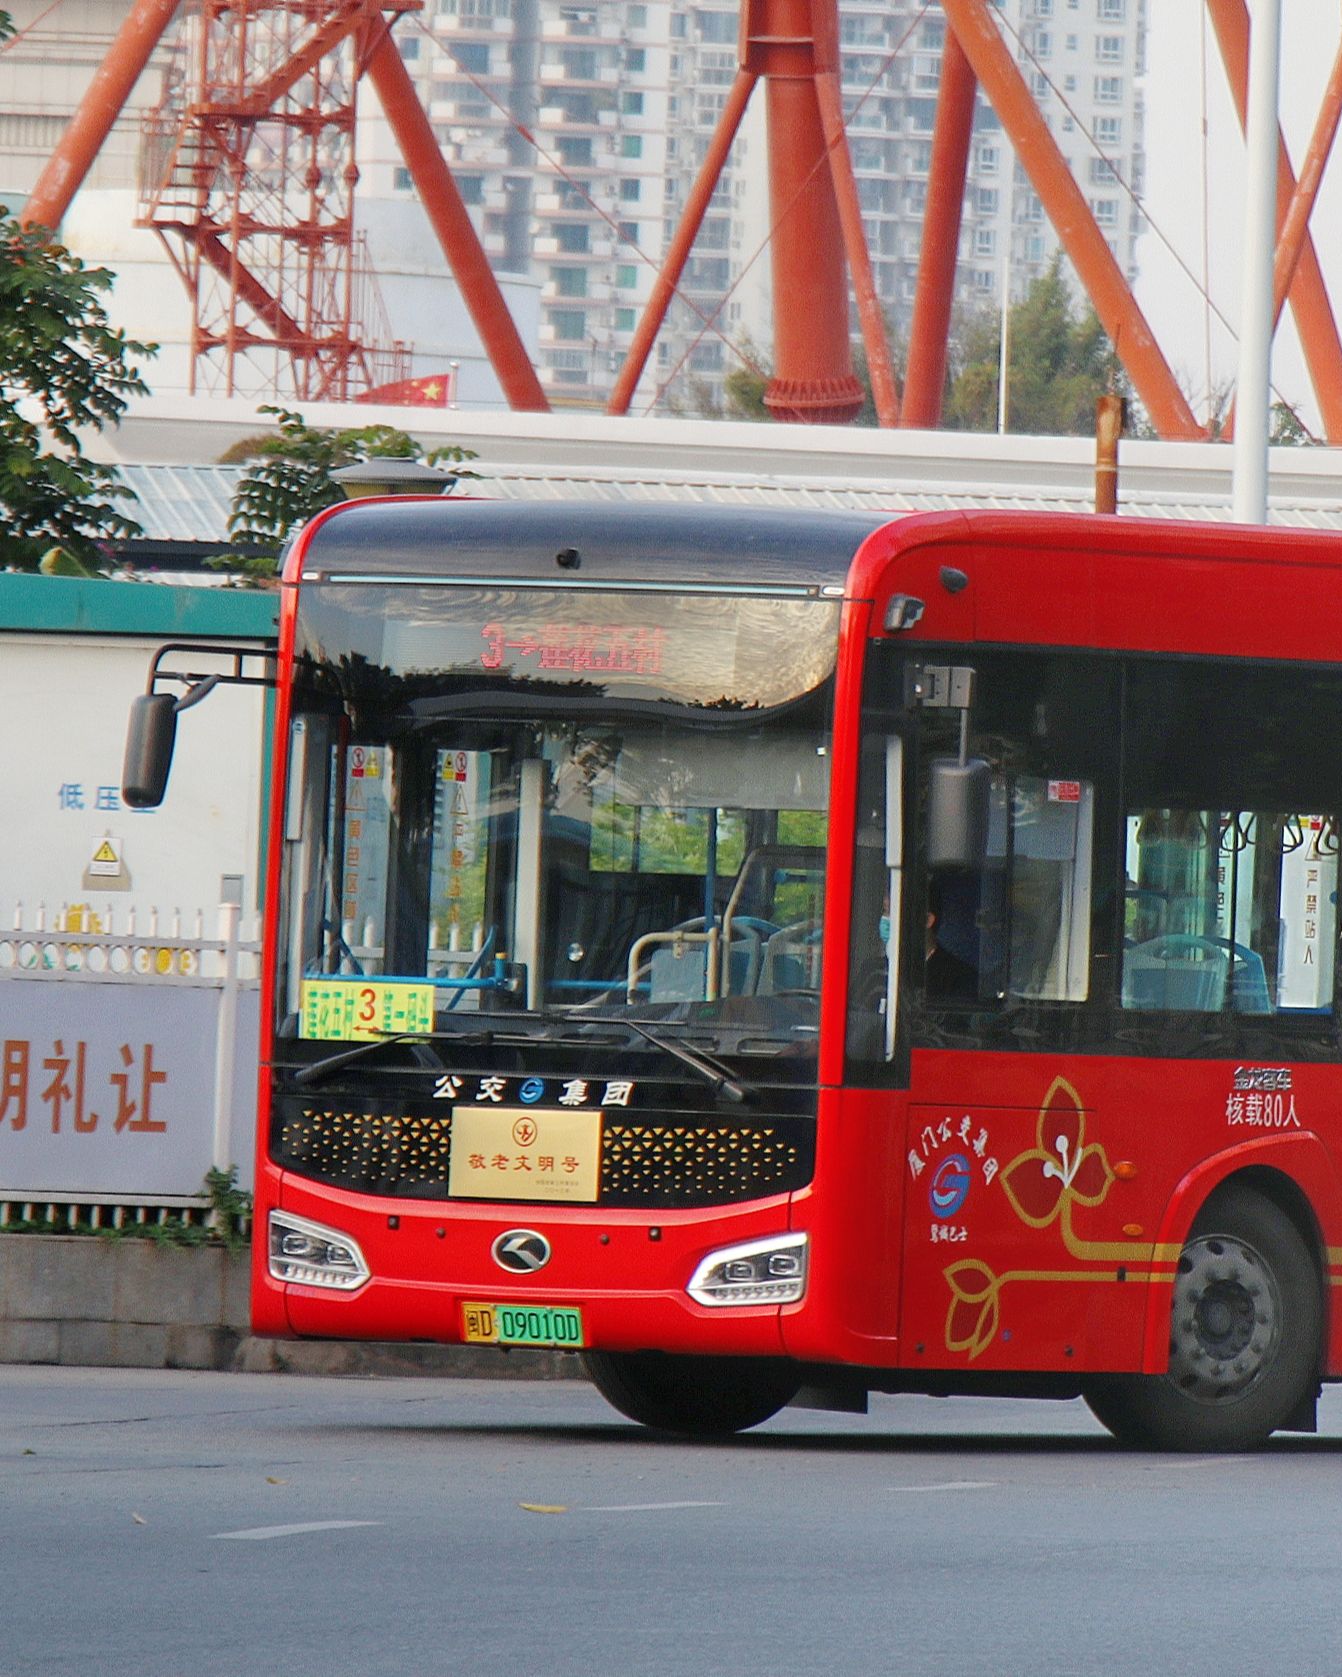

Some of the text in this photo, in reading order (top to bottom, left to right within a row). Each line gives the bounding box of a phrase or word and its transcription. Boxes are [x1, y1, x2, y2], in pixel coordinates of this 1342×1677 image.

[480, 623, 506, 668] 3
[58, 783, 157, 813] 低压
[1303, 869, 1318, 965] 严禁站人
[359, 988, 376, 1021] 3
[432, 1074, 634, 1107] 公交集团
[1225, 1093, 1301, 1127] 核载80人
[468, 1153, 580, 1174] 敬老文明号
